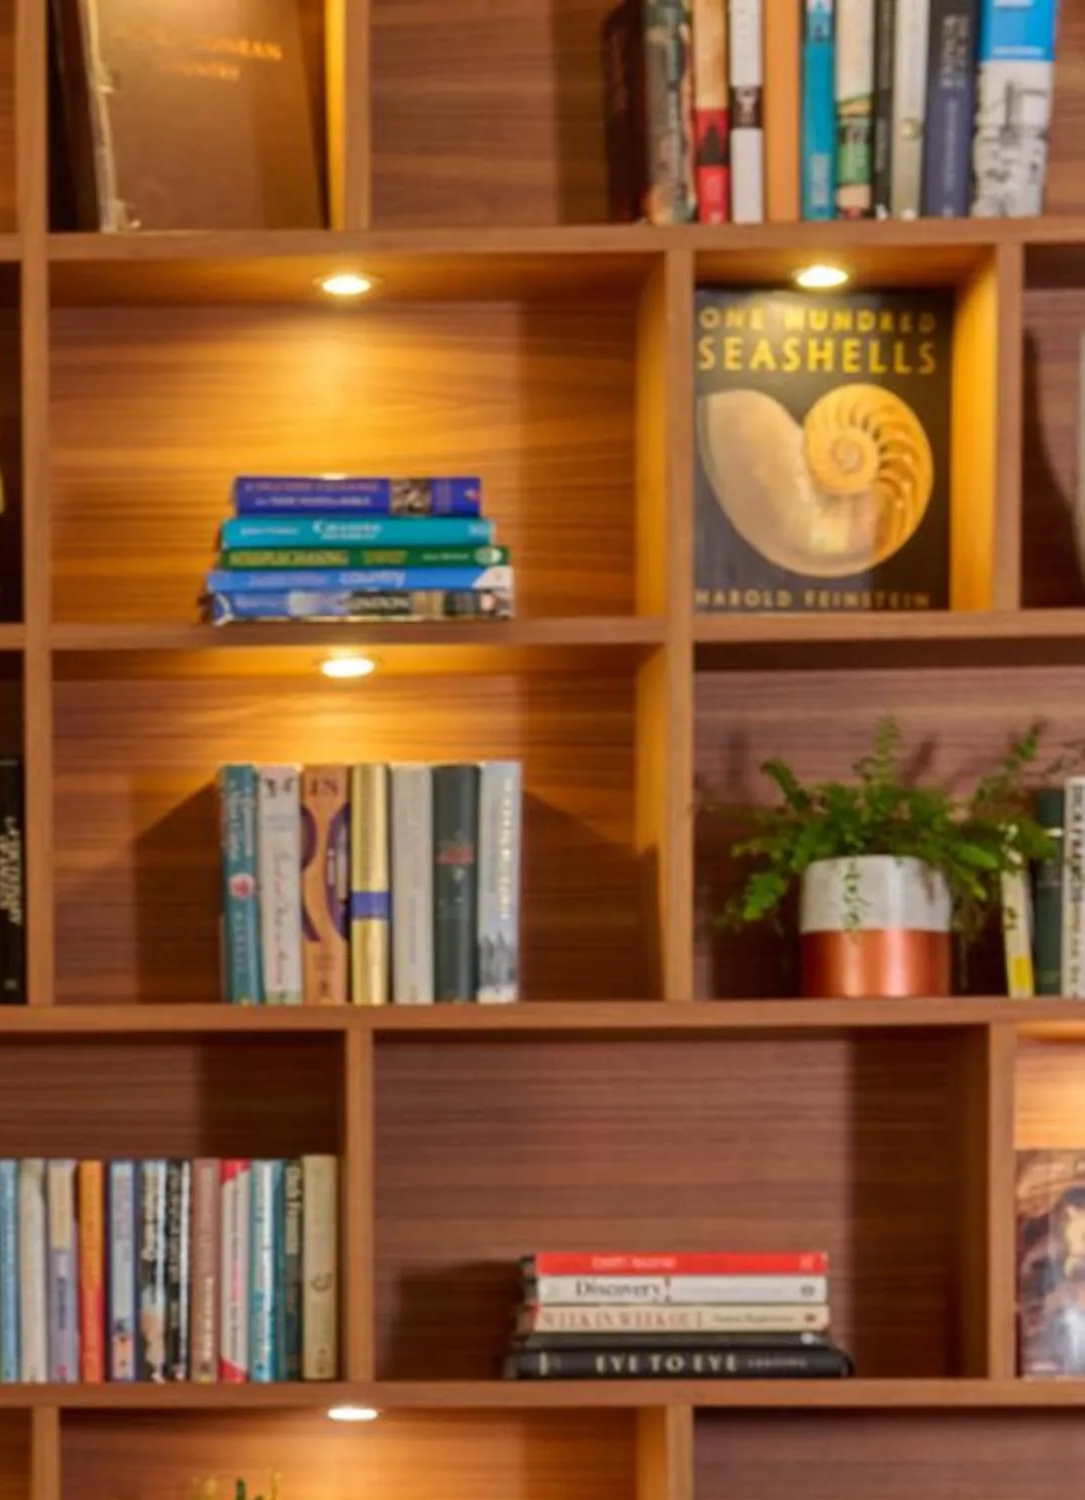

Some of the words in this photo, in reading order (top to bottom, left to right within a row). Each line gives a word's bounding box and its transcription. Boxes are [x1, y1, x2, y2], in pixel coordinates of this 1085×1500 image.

[699, 307, 766, 331] ONE
[783, 306, 937, 334] HUNDRED
[697, 336, 937, 375] SEASHELLS
[694, 588, 793, 609] HAROLD
[595, 1354, 638, 1374] EYE
[649, 1354, 684, 1374] TO
[693, 1354, 738, 1374] EYE
